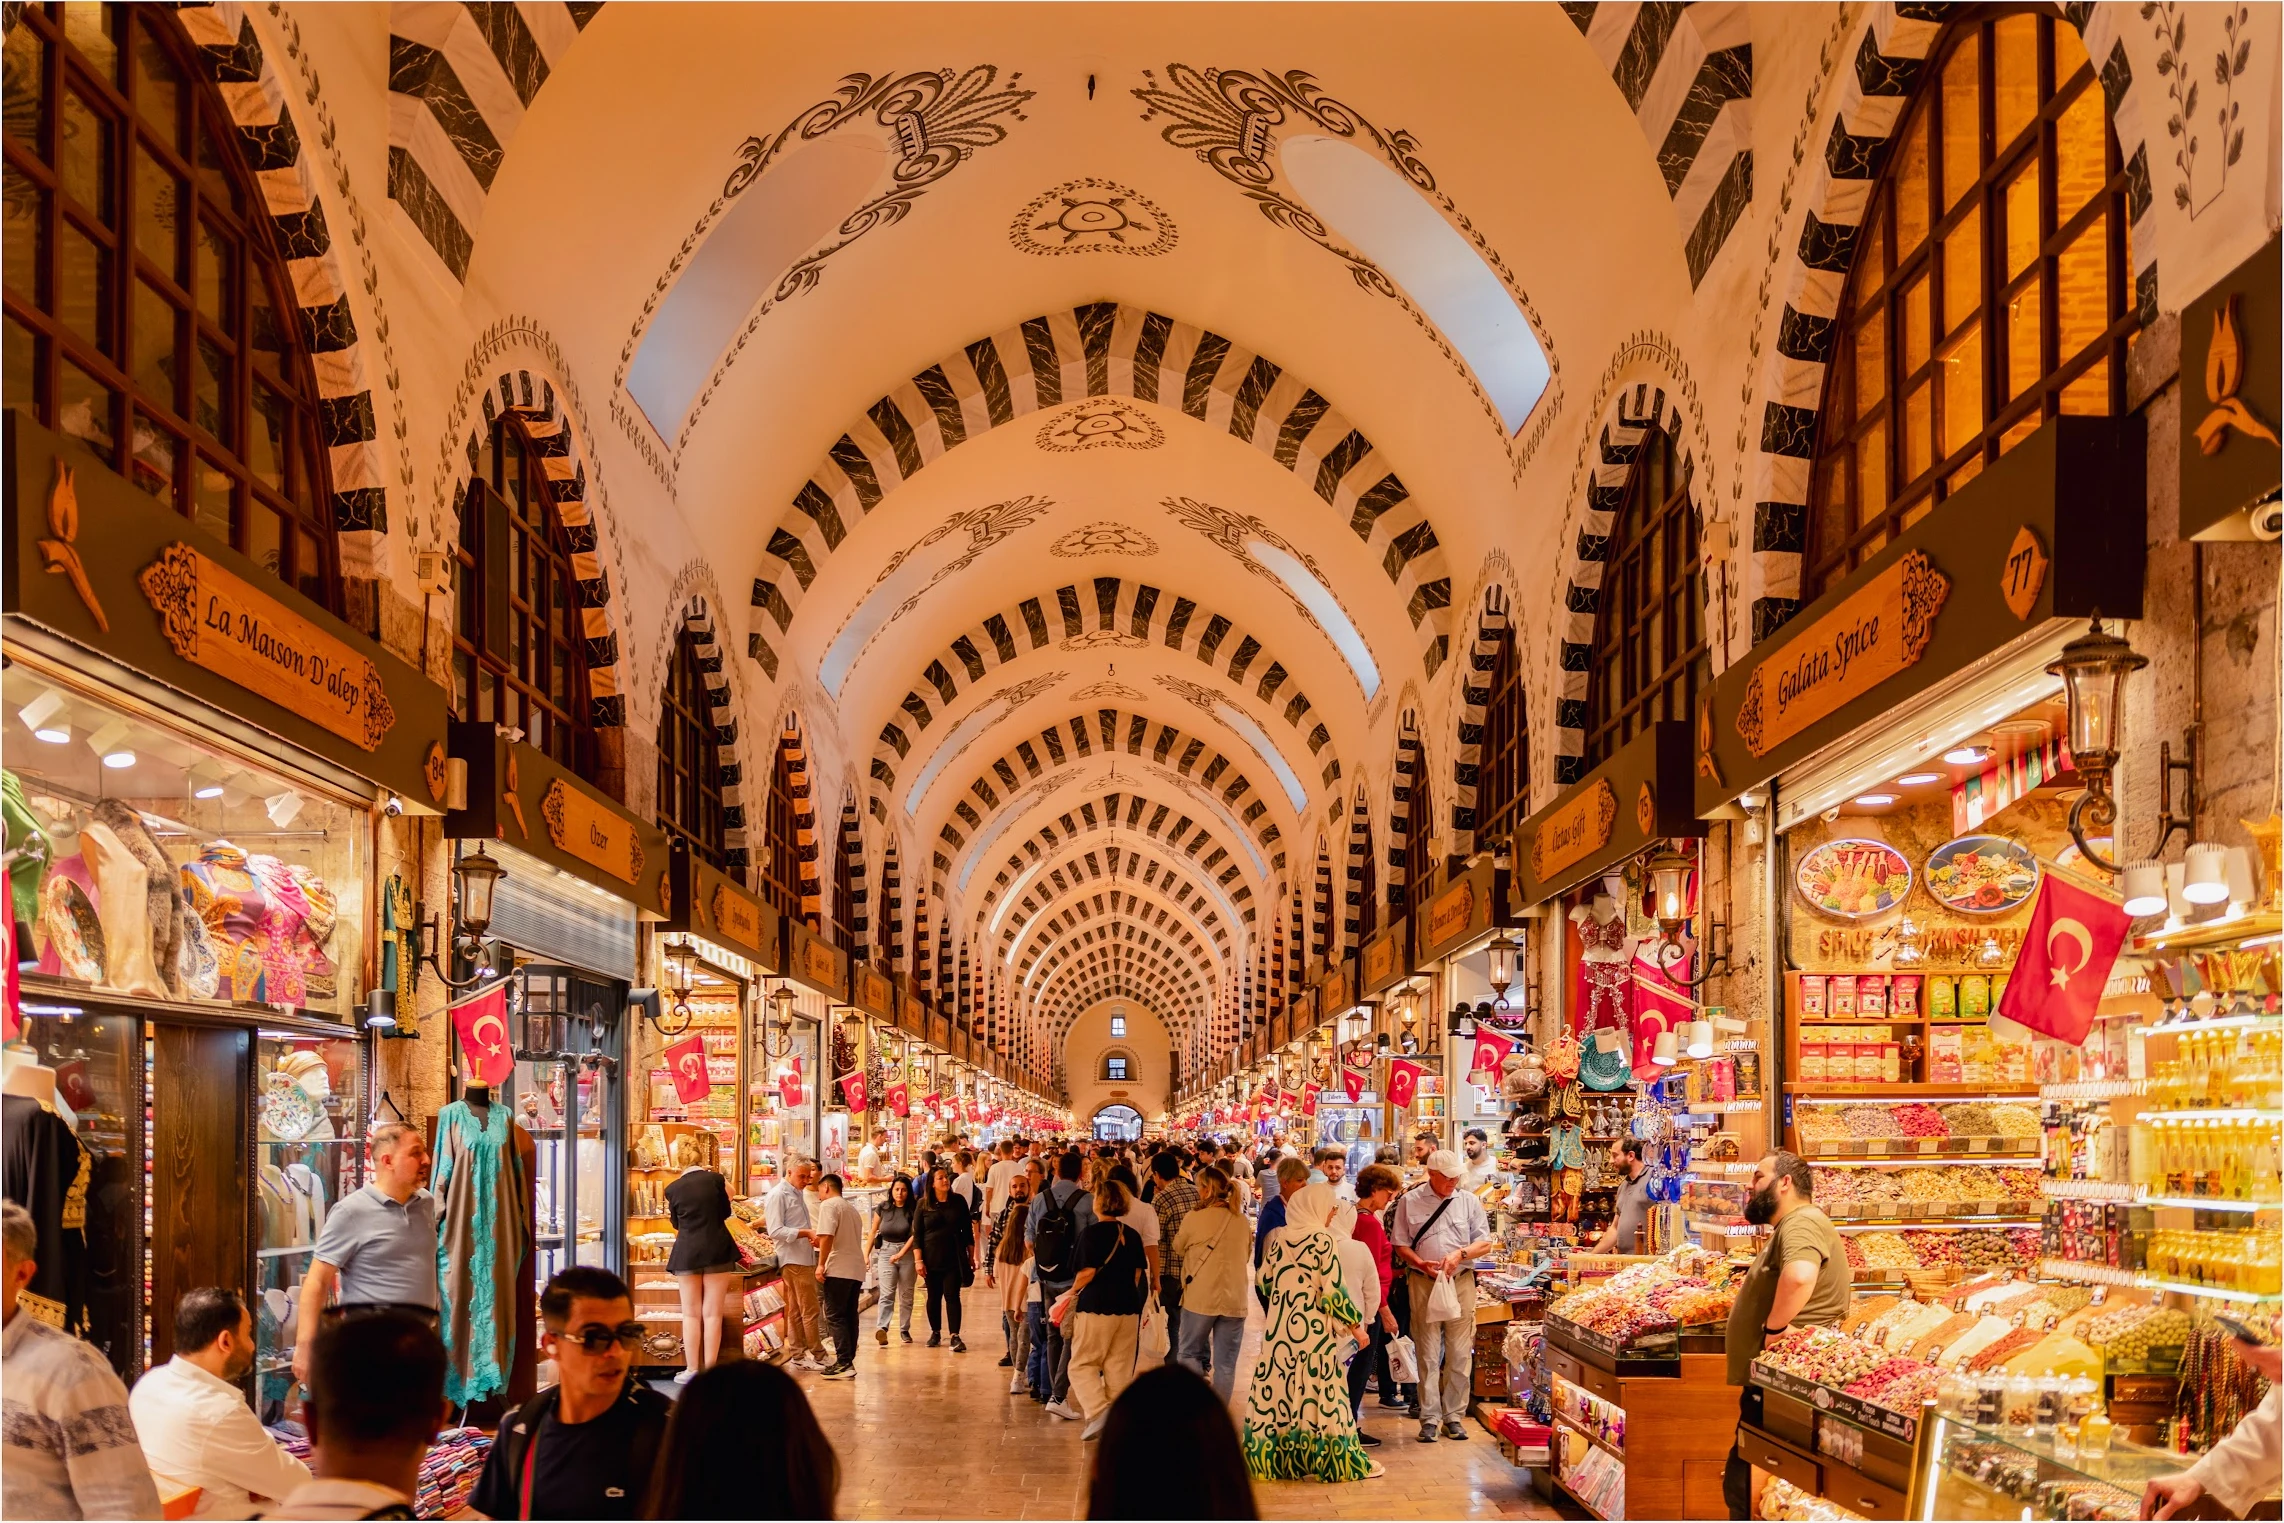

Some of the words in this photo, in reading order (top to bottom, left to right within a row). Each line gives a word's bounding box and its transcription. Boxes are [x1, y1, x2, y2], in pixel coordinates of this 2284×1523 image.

[2010, 546, 2033, 597] 77
[204, 595, 232, 636] La
[309, 655, 359, 715] D'alep
[1778, 650, 1830, 714] Galata
[1834, 615, 1879, 682] Spice
[432, 755, 445, 784] 84
[1639, 795, 1649, 822] 75
[590, 819, 609, 851] Özer
[1572, 807, 1586, 848] Gift
[1818, 929, 1874, 952] SPICE
